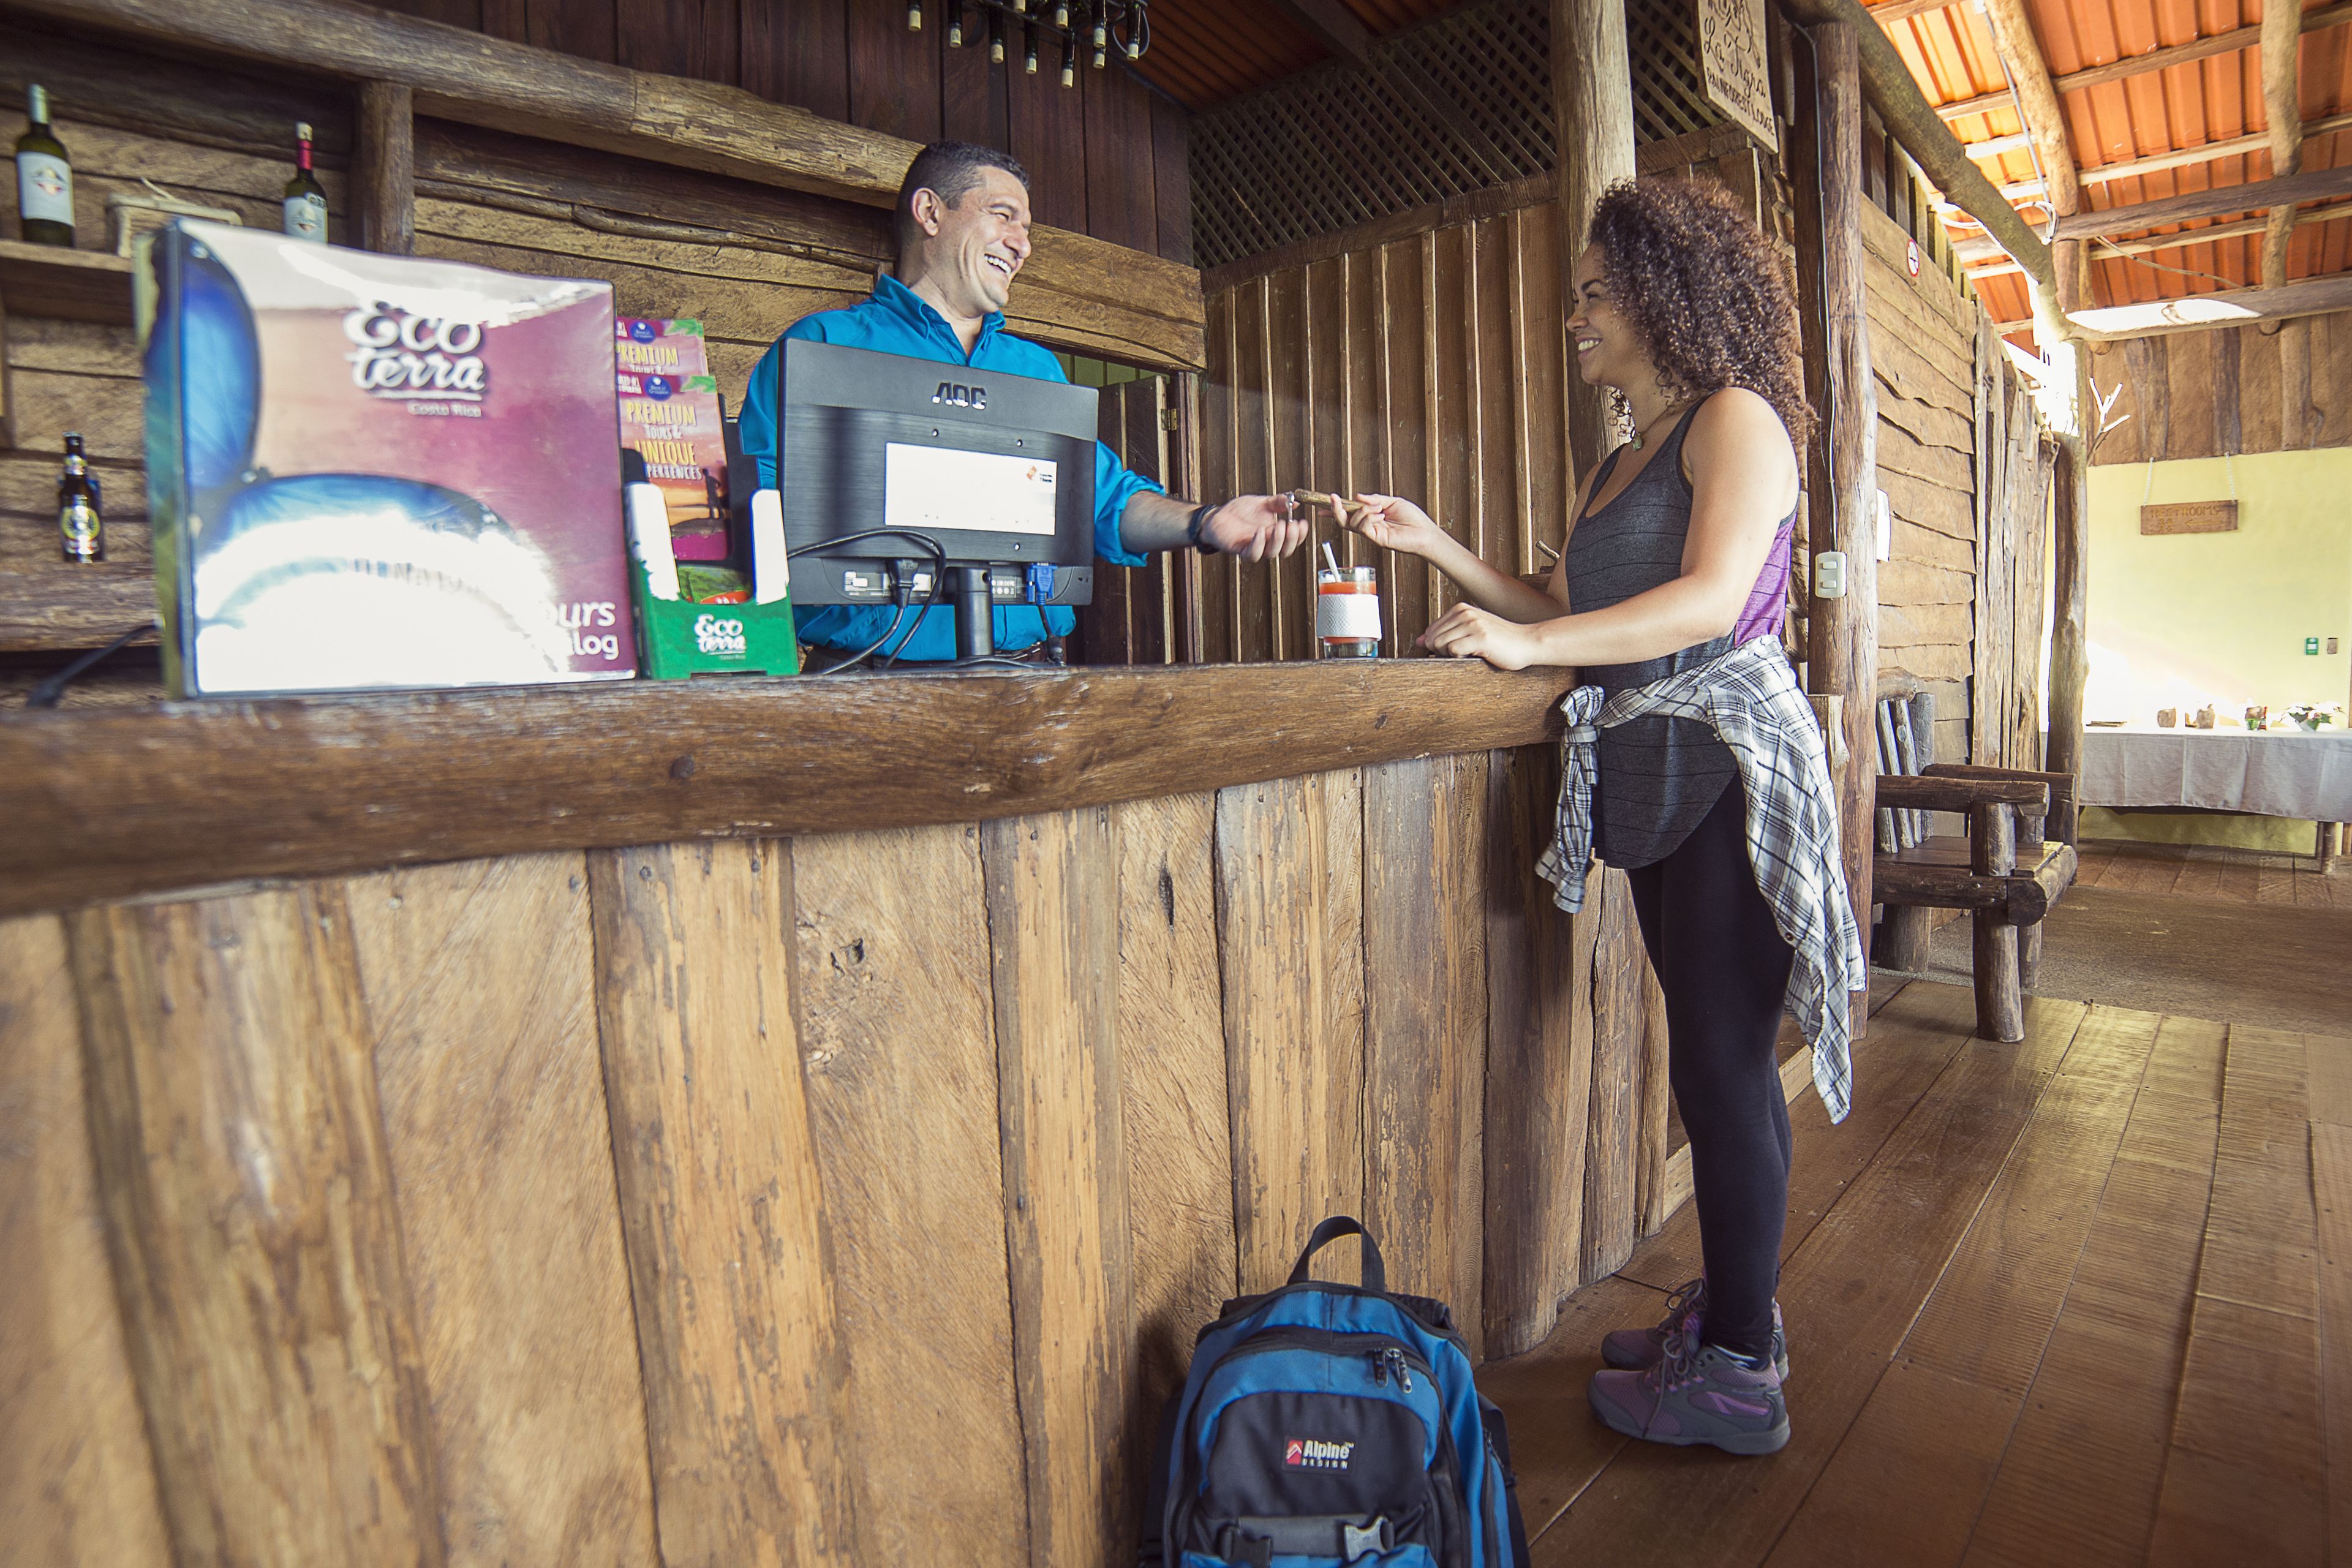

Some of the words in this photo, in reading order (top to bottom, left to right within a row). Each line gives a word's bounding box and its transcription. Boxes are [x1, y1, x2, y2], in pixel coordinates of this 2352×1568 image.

[343, 298, 481, 355] Eco
[344, 346, 485, 391] terra
[931, 382, 987, 410] AOC
[627, 401, 697, 426] PREMIUM
[644, 424, 672, 440] TOURS
[634, 440, 698, 467] UNIQUE
[646, 464, 703, 480] PERIENCES
[2150, 505, 2220, 518] RESTROOMS
[556, 601, 616, 628] urs
[694, 613, 743, 638] Eco
[696, 635, 747, 653] terra
[1303, 1439, 1350, 1460] Alpine
[1302, 1458, 1348, 1469] DESIGN
